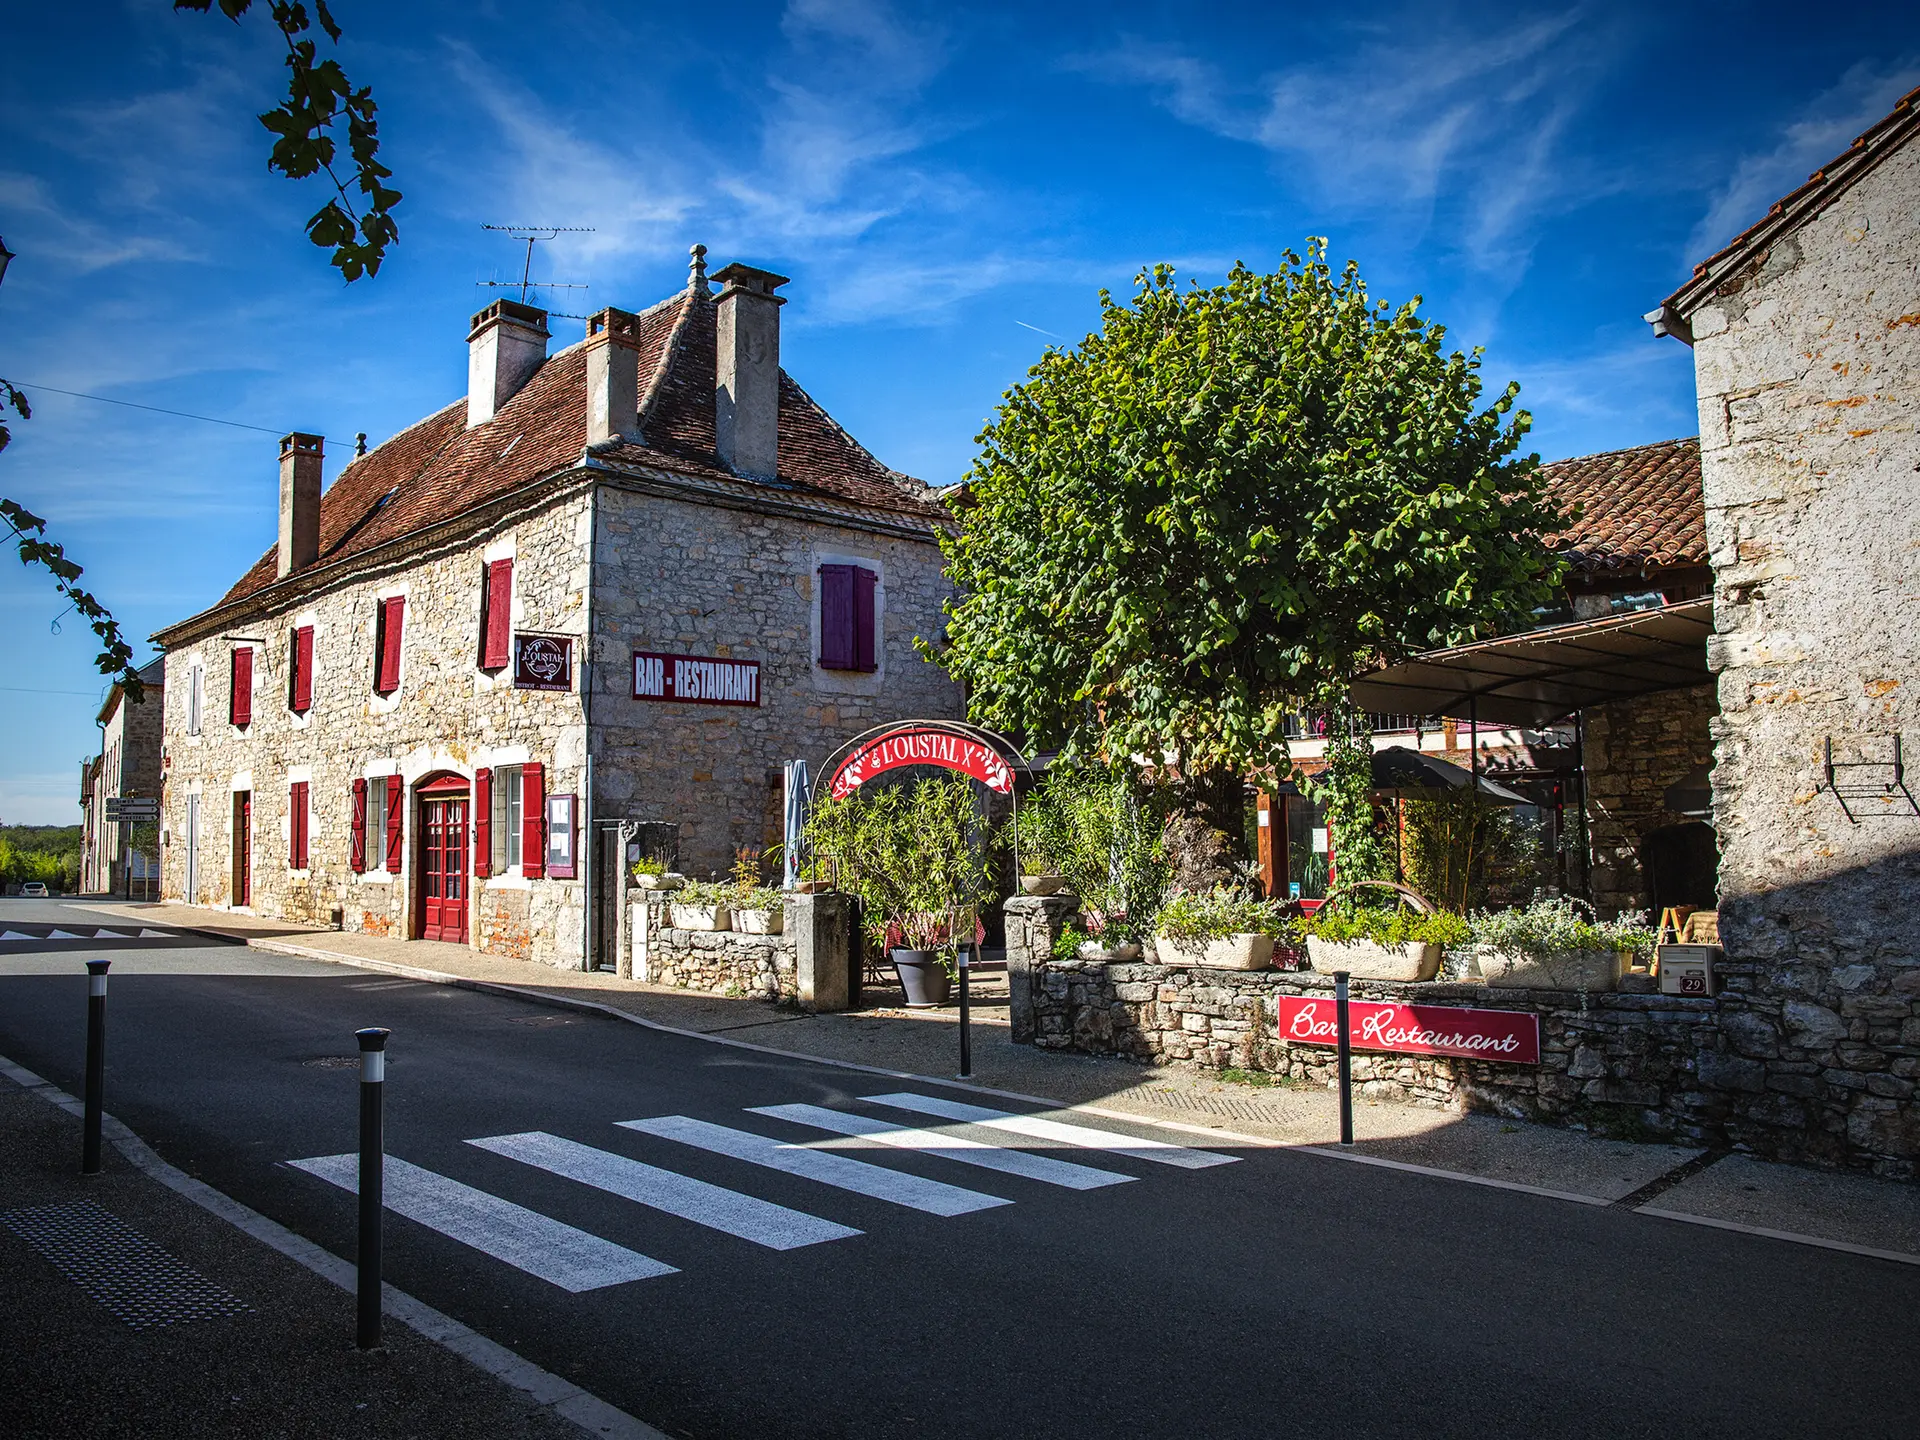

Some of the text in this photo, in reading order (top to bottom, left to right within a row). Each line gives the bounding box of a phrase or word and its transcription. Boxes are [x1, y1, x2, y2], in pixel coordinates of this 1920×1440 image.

[635, 656, 664, 696] BAR
[675, 659, 758, 702] RESTAURANT
[883, 733, 959, 765] L'OUSTAL
[1685, 979, 1701, 991] 29
[1290, 1002, 1338, 1038] Bar
[1362, 1007, 1520, 1054] Restaurant
